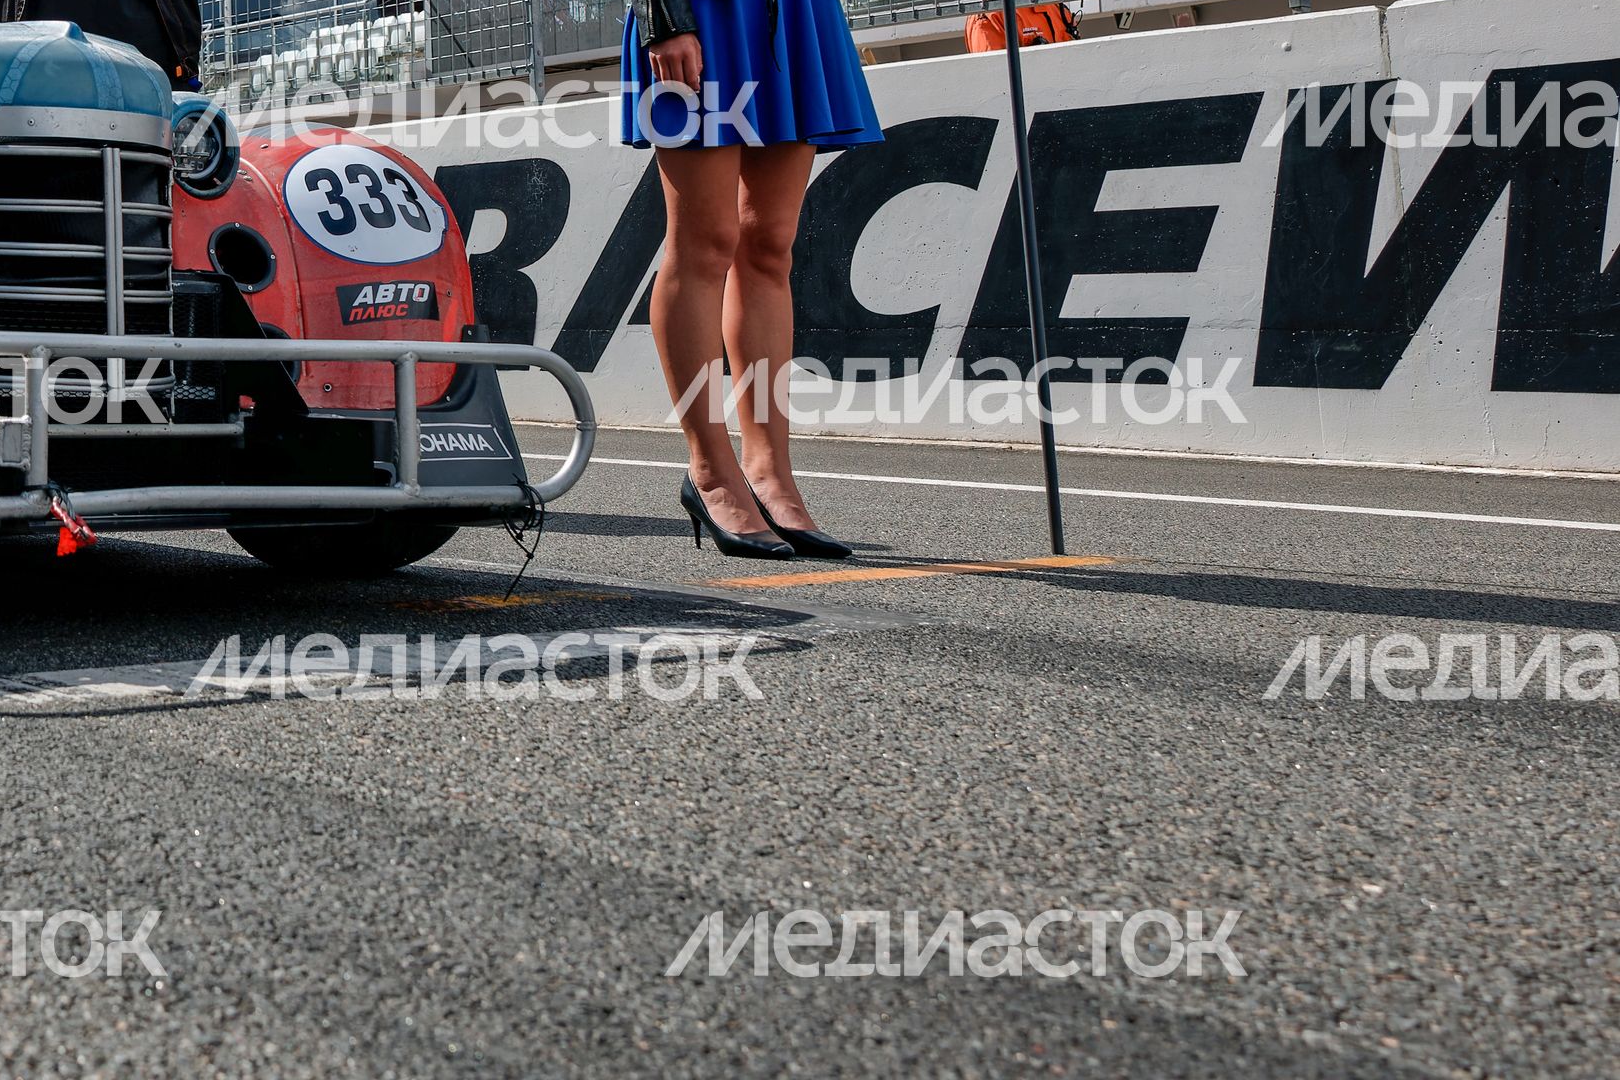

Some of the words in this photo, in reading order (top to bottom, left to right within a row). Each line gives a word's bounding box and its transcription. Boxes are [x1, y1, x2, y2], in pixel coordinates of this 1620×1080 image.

[304, 163, 432, 236] 333
[352, 283, 431, 307] АВТО
[349, 304, 409, 322] ПЛЮС
[420, 432, 495, 453] OHAMA
